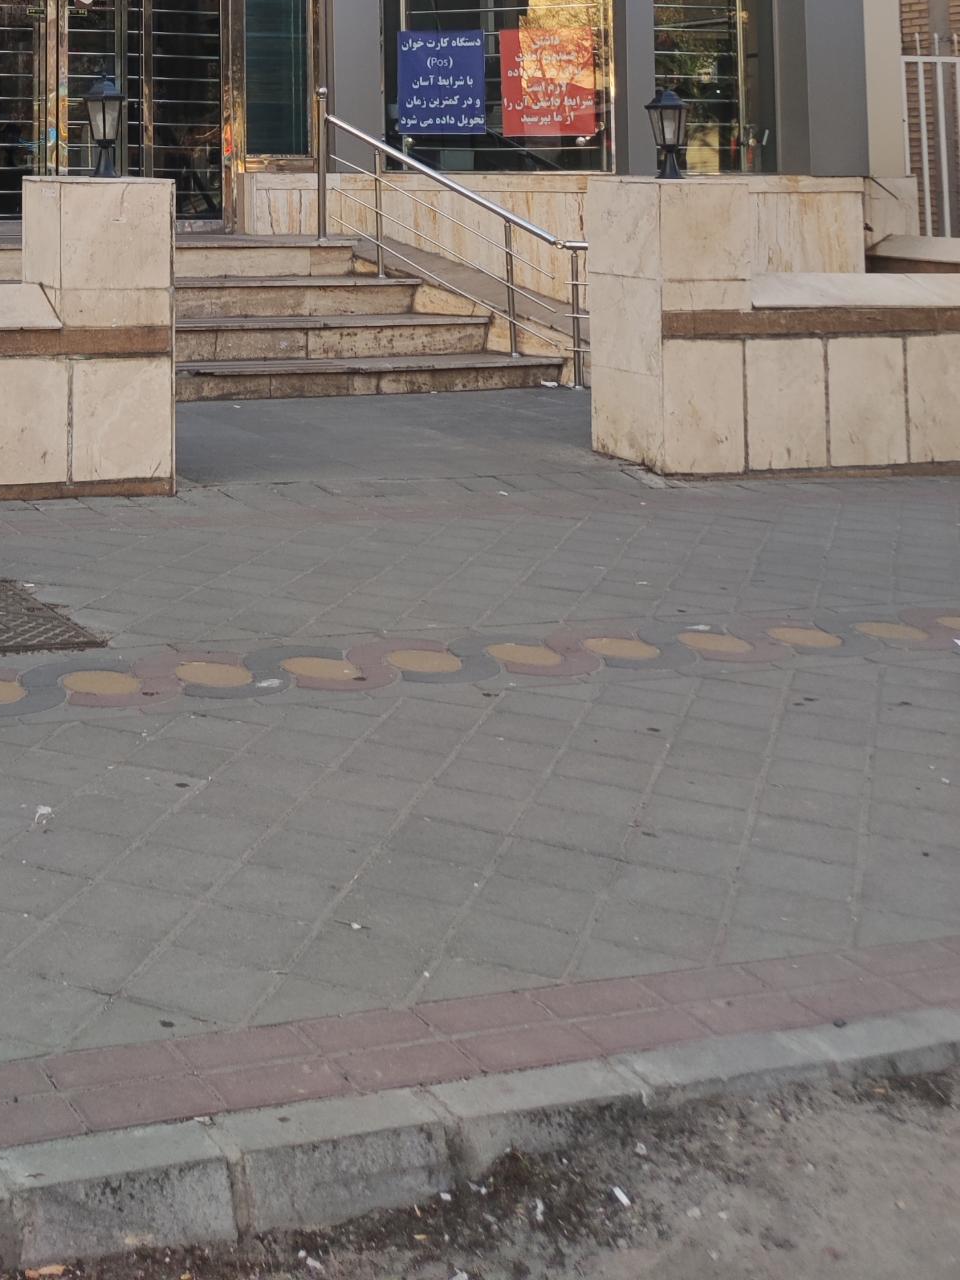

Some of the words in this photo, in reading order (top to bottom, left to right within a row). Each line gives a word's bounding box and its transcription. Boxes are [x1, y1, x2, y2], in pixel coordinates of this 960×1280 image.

[401, 38, 424, 51] خوان
[426, 37, 450, 49] کارت
[451, 37, 481, 47] دستگاه
[427, 56, 453, 69] (Pos)
[412, 75, 435, 89] آسان
[437, 76, 465, 88] شرایط
[466, 76, 474, 88] با
[405, 95, 427, 108] زمان
[429, 95, 460, 108] کمترین
[462, 97, 473, 108] در
[504, 98, 513, 111] را
[515, 96, 529, 110] آن
[532, 96, 561, 109] داشتن
[563, 96, 593, 109] شرایط
[400, 115, 418, 127] شود
[419, 118, 434, 127] می
[436, 115, 455, 124] داده
[457, 114, 485, 127] تحویل
[520, 113, 551, 125] بپرسید
[553, 112, 563, 122] ما
[565, 111, 574, 124] از
